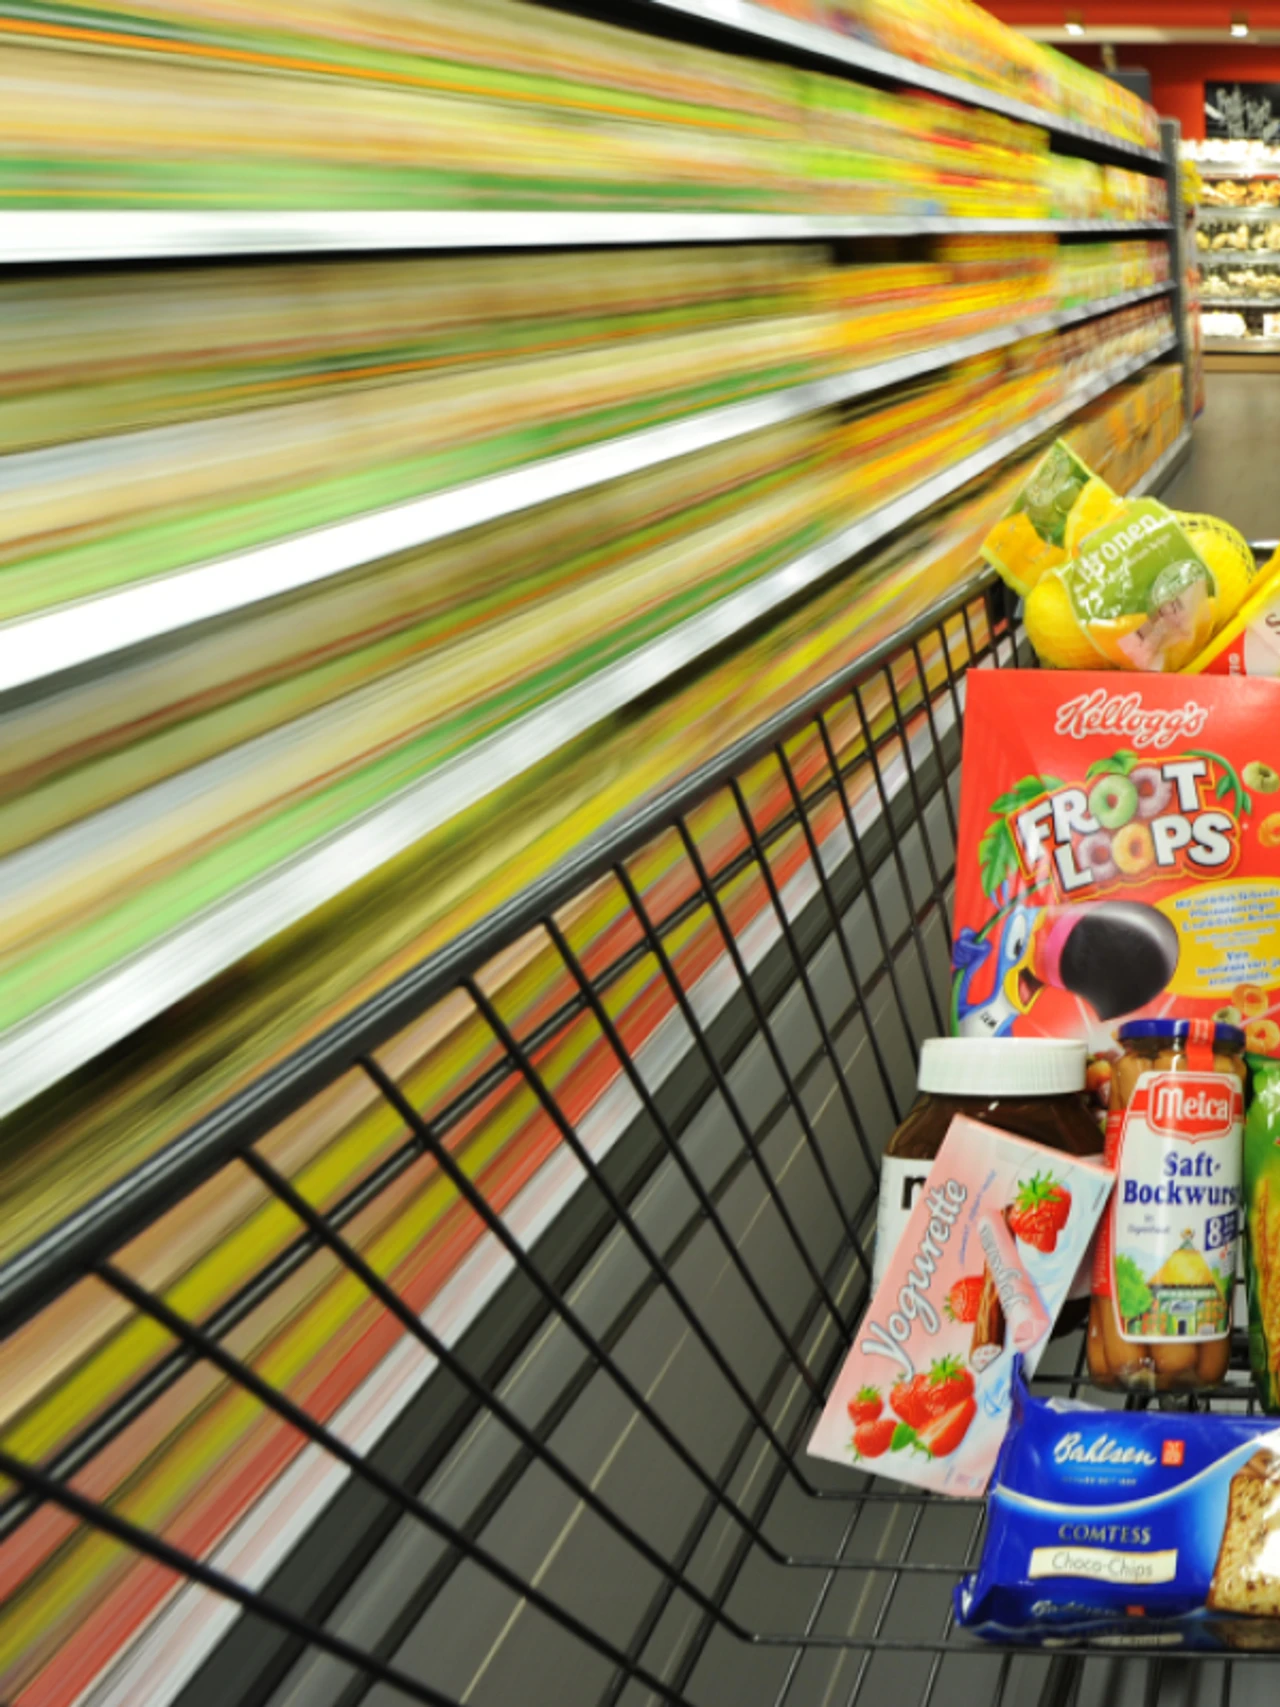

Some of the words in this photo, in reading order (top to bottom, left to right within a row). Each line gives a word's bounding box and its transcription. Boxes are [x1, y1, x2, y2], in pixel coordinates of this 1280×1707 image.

[1054, 688, 1209, 749] Kellogg's
[1016, 759, 1208, 866] FROOT
[1053, 812, 1233, 893] LOOPS
[1154, 1085, 1229, 1122] Meica
[1163, 1151, 1222, 1177] Saft-
[1123, 1177, 1240, 1206] Bockwurs
[1208, 1218, 1222, 1248] 8
[860, 1177, 968, 1383] Yogurette
[1053, 1430, 1157, 1467] Bahlsen
[1058, 1522, 1151, 1546] COMTESS
[1051, 1551, 1153, 1583] Choco-Chips
